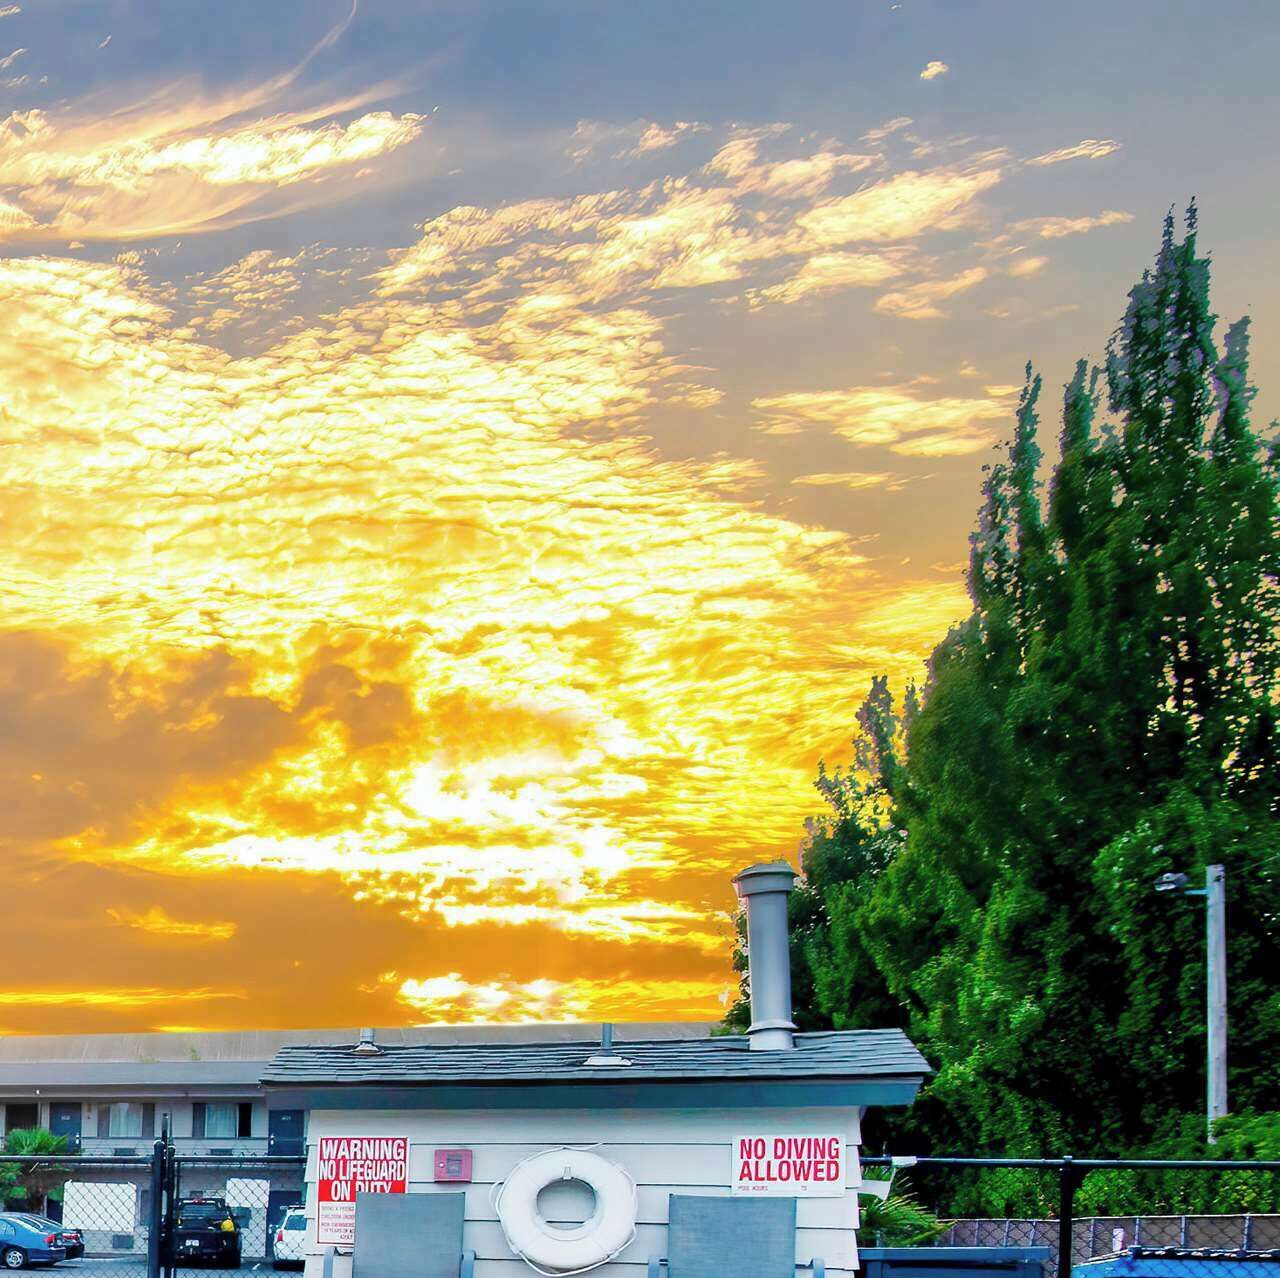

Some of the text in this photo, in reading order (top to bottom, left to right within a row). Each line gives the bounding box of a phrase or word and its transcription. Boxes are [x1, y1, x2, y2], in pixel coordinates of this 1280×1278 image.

[321, 1139, 405, 1160] WARNING
[740, 1137, 840, 1160] NO DIVING
[320, 1160, 405, 1181] NO LIFEGUARD
[739, 1160, 840, 1182] ALLOWED
[331, 1180, 351, 1201] ON
